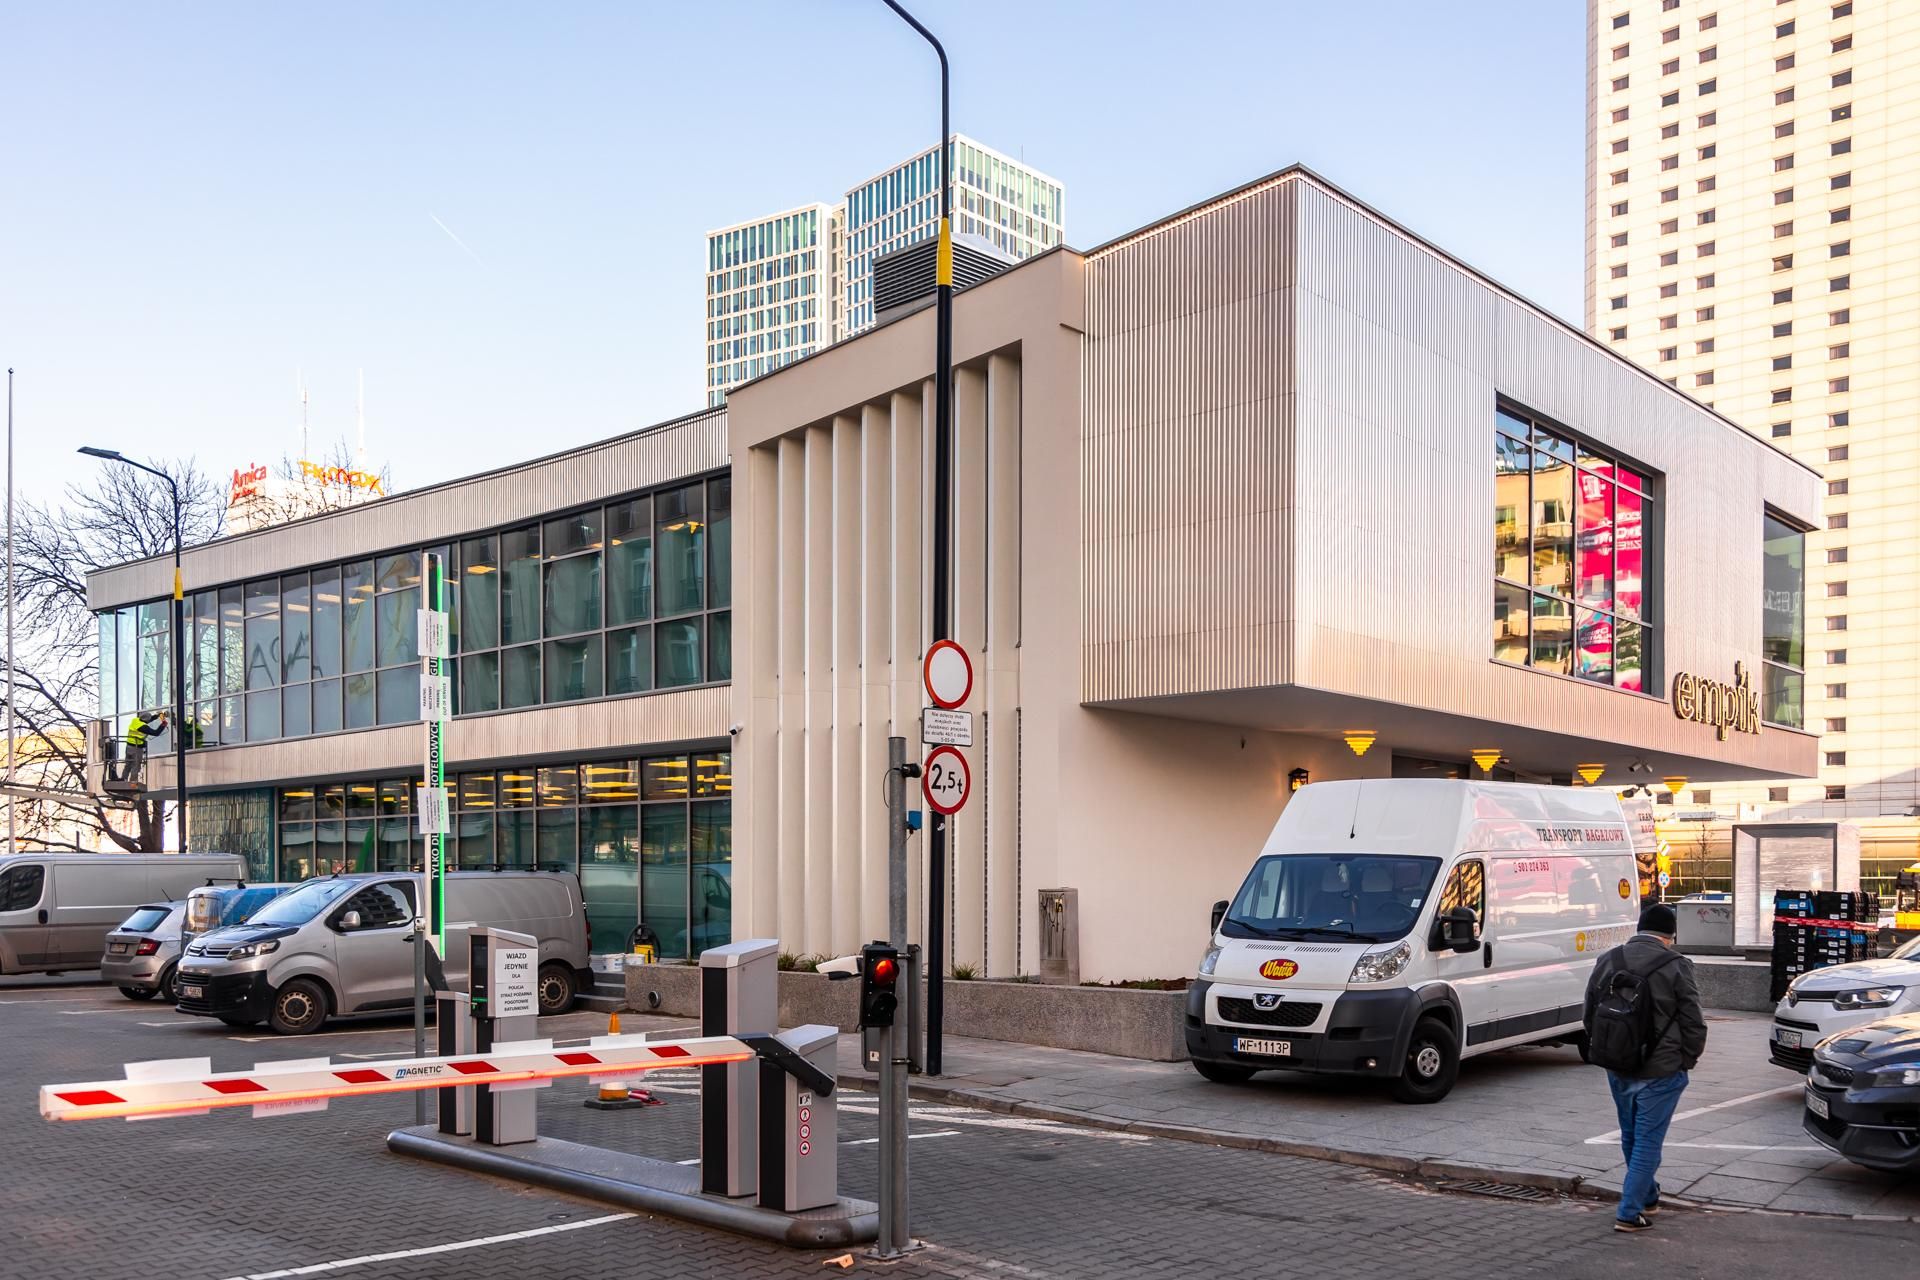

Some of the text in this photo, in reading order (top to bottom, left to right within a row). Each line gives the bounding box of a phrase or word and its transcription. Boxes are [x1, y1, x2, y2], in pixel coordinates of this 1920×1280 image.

[232, 462, 267, 489] Amica
[1673, 660, 1762, 741] empik
[431, 720, 439, 788] HOTELOWYCH
[432, 833, 440, 846] DL
[1536, 828, 1582, 842] TRANSPORT
[432, 848, 440, 879] TYLKO
[1263, 960, 1294, 977] Wawa
[1240, 1040, 1289, 1054] WF 1113P
